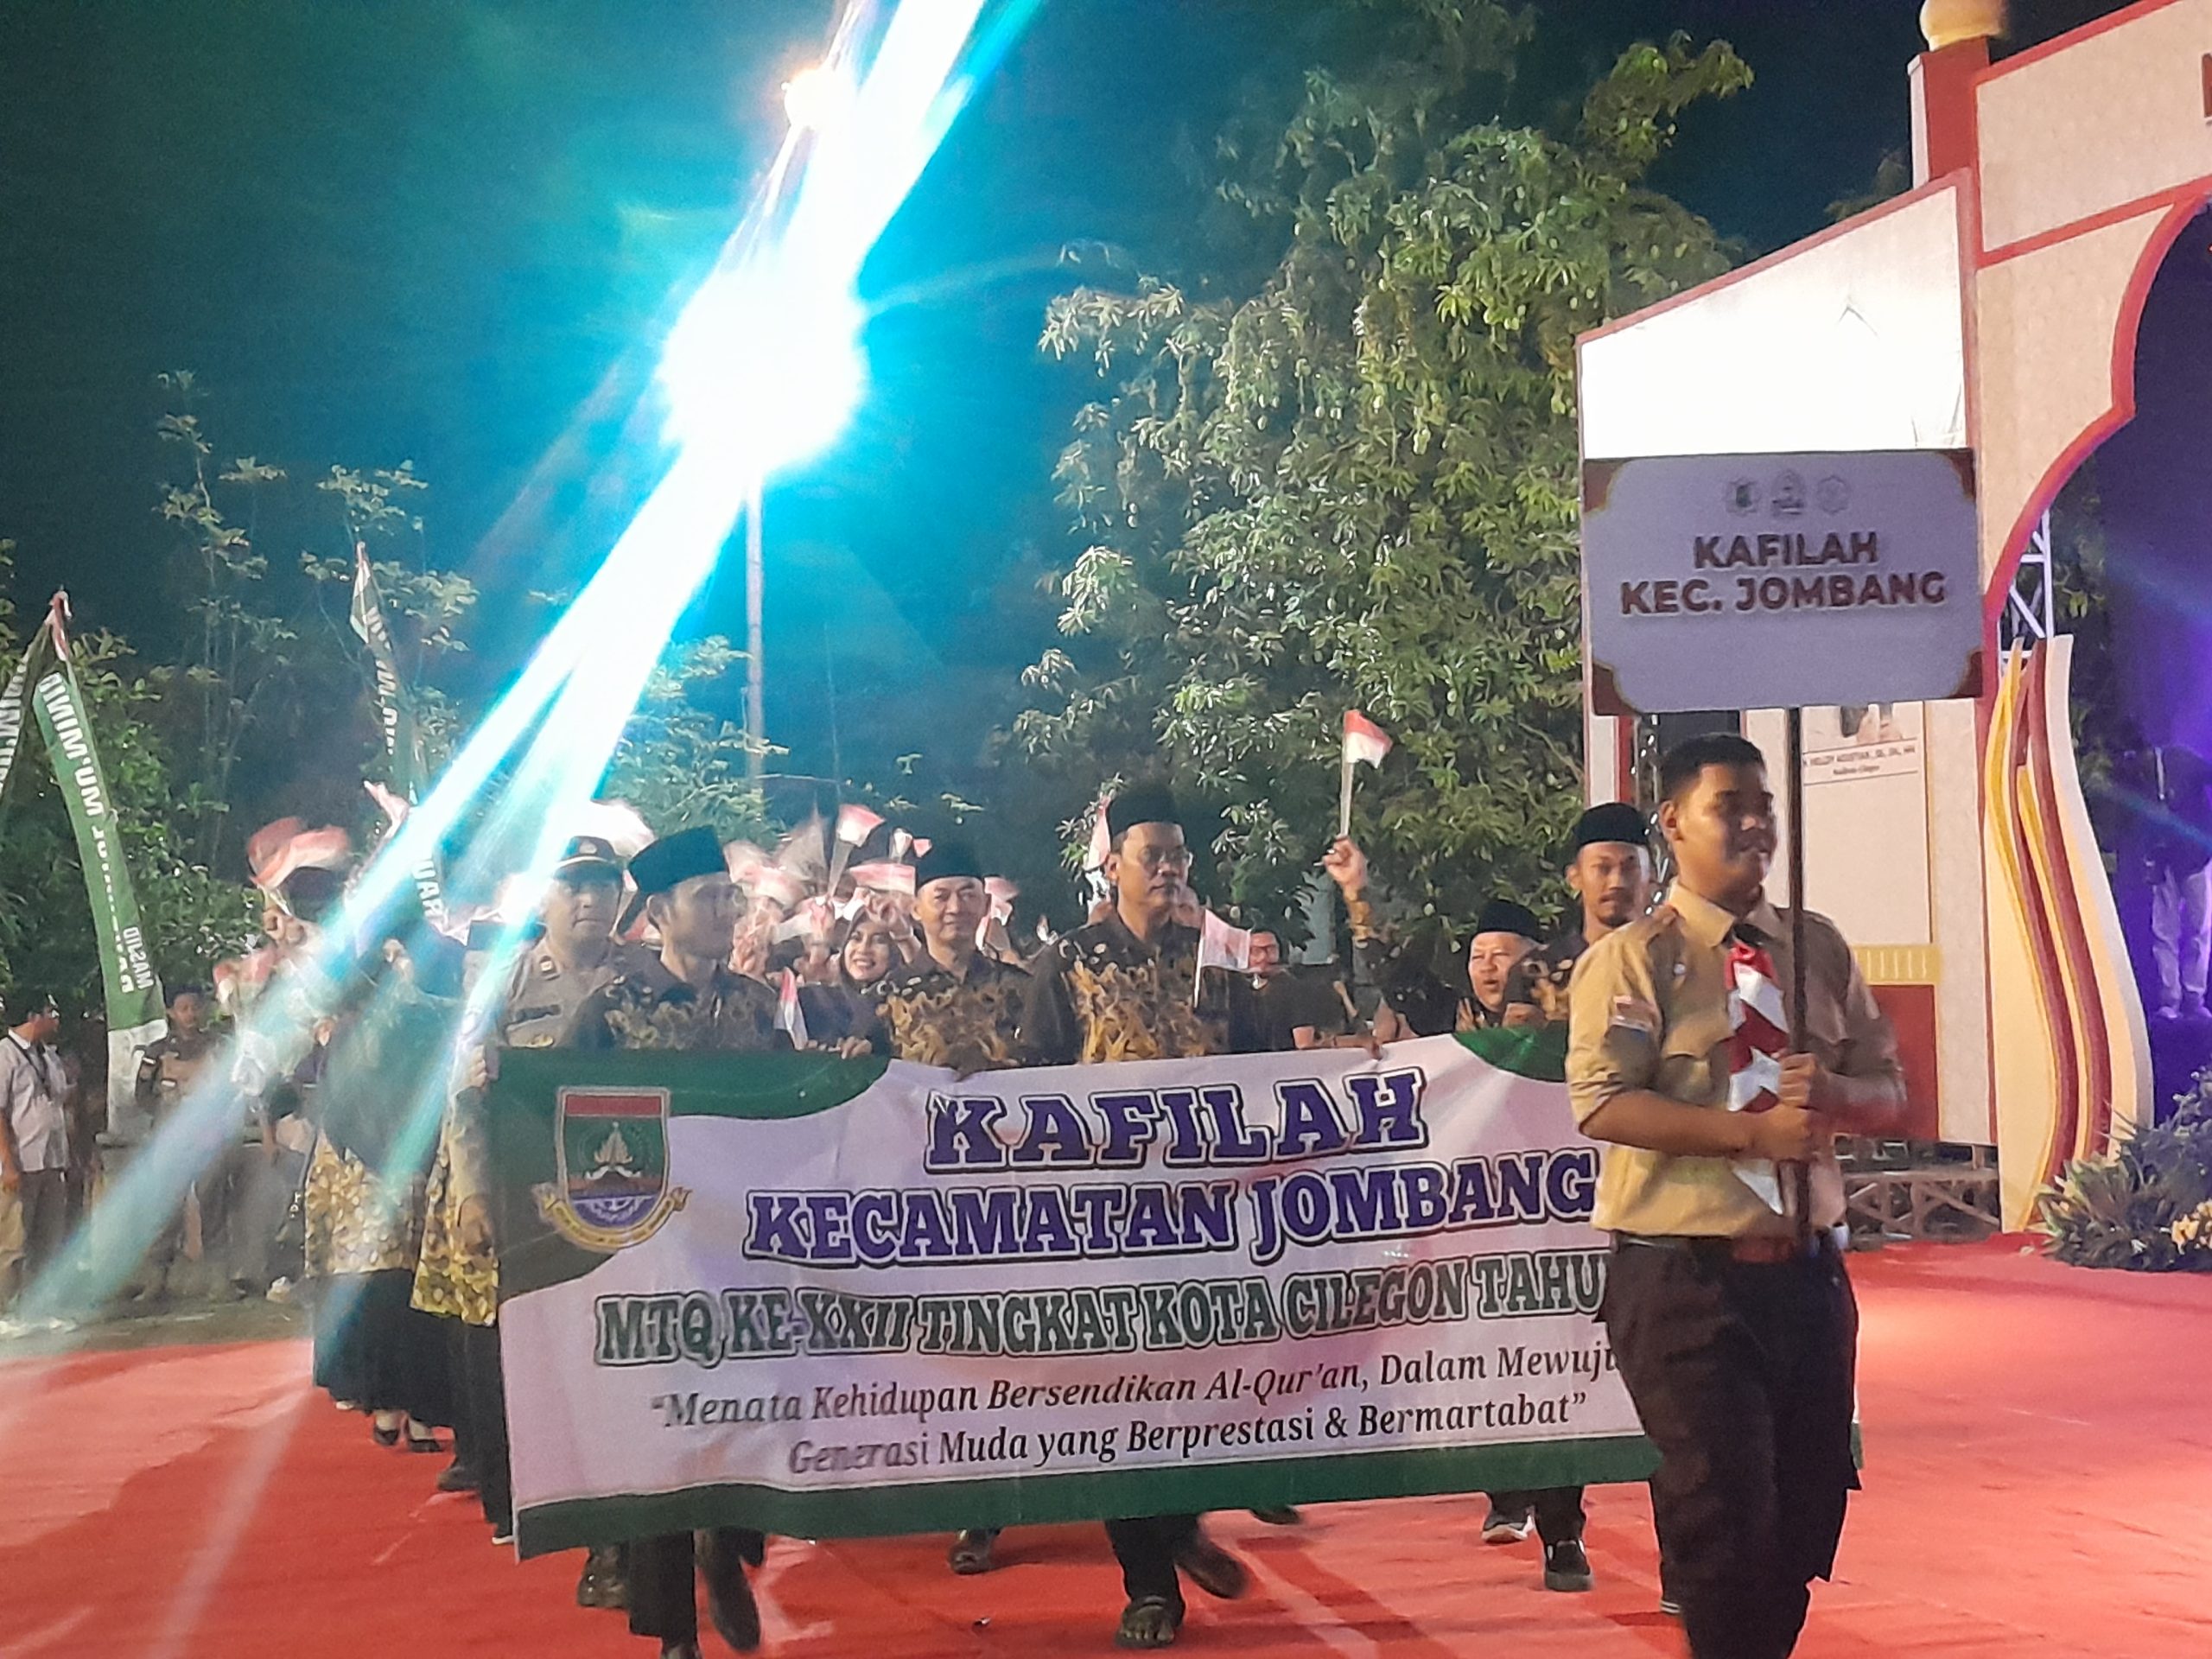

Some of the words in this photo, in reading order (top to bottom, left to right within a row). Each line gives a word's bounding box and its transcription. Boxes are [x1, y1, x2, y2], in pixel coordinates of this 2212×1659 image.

[1693, 531, 1878, 569] KAFILAH
[1620, 579, 1722, 614] KEC.
[1736, 570, 1946, 610] JOMBANG
[925, 1069, 1427, 1173] KAFILAH
[744, 1181, 1239, 1267] KECAMATAN
[1250, 1147, 1599, 1265] JOMBANG
[596, 1291, 723, 1368] MTQ
[918, 1286, 1138, 1357] TINGKAT
[1141, 1277, 1281, 1351] KOTA
[1281, 1254, 1471, 1338] CILEGON
[1472, 1249, 1608, 1321] TAHU
[810, 1381, 978, 1423] Kehidupan
[987, 1374, 1197, 1410] Bersendikan
[1381, 1350, 1487, 1385] Dalam
[938, 1426, 1028, 1465] Muda
[1033, 1427, 1119, 1468] yang
[1126, 1407, 1314, 1459] Berprestasi
[1325, 1406, 1349, 1439] &
